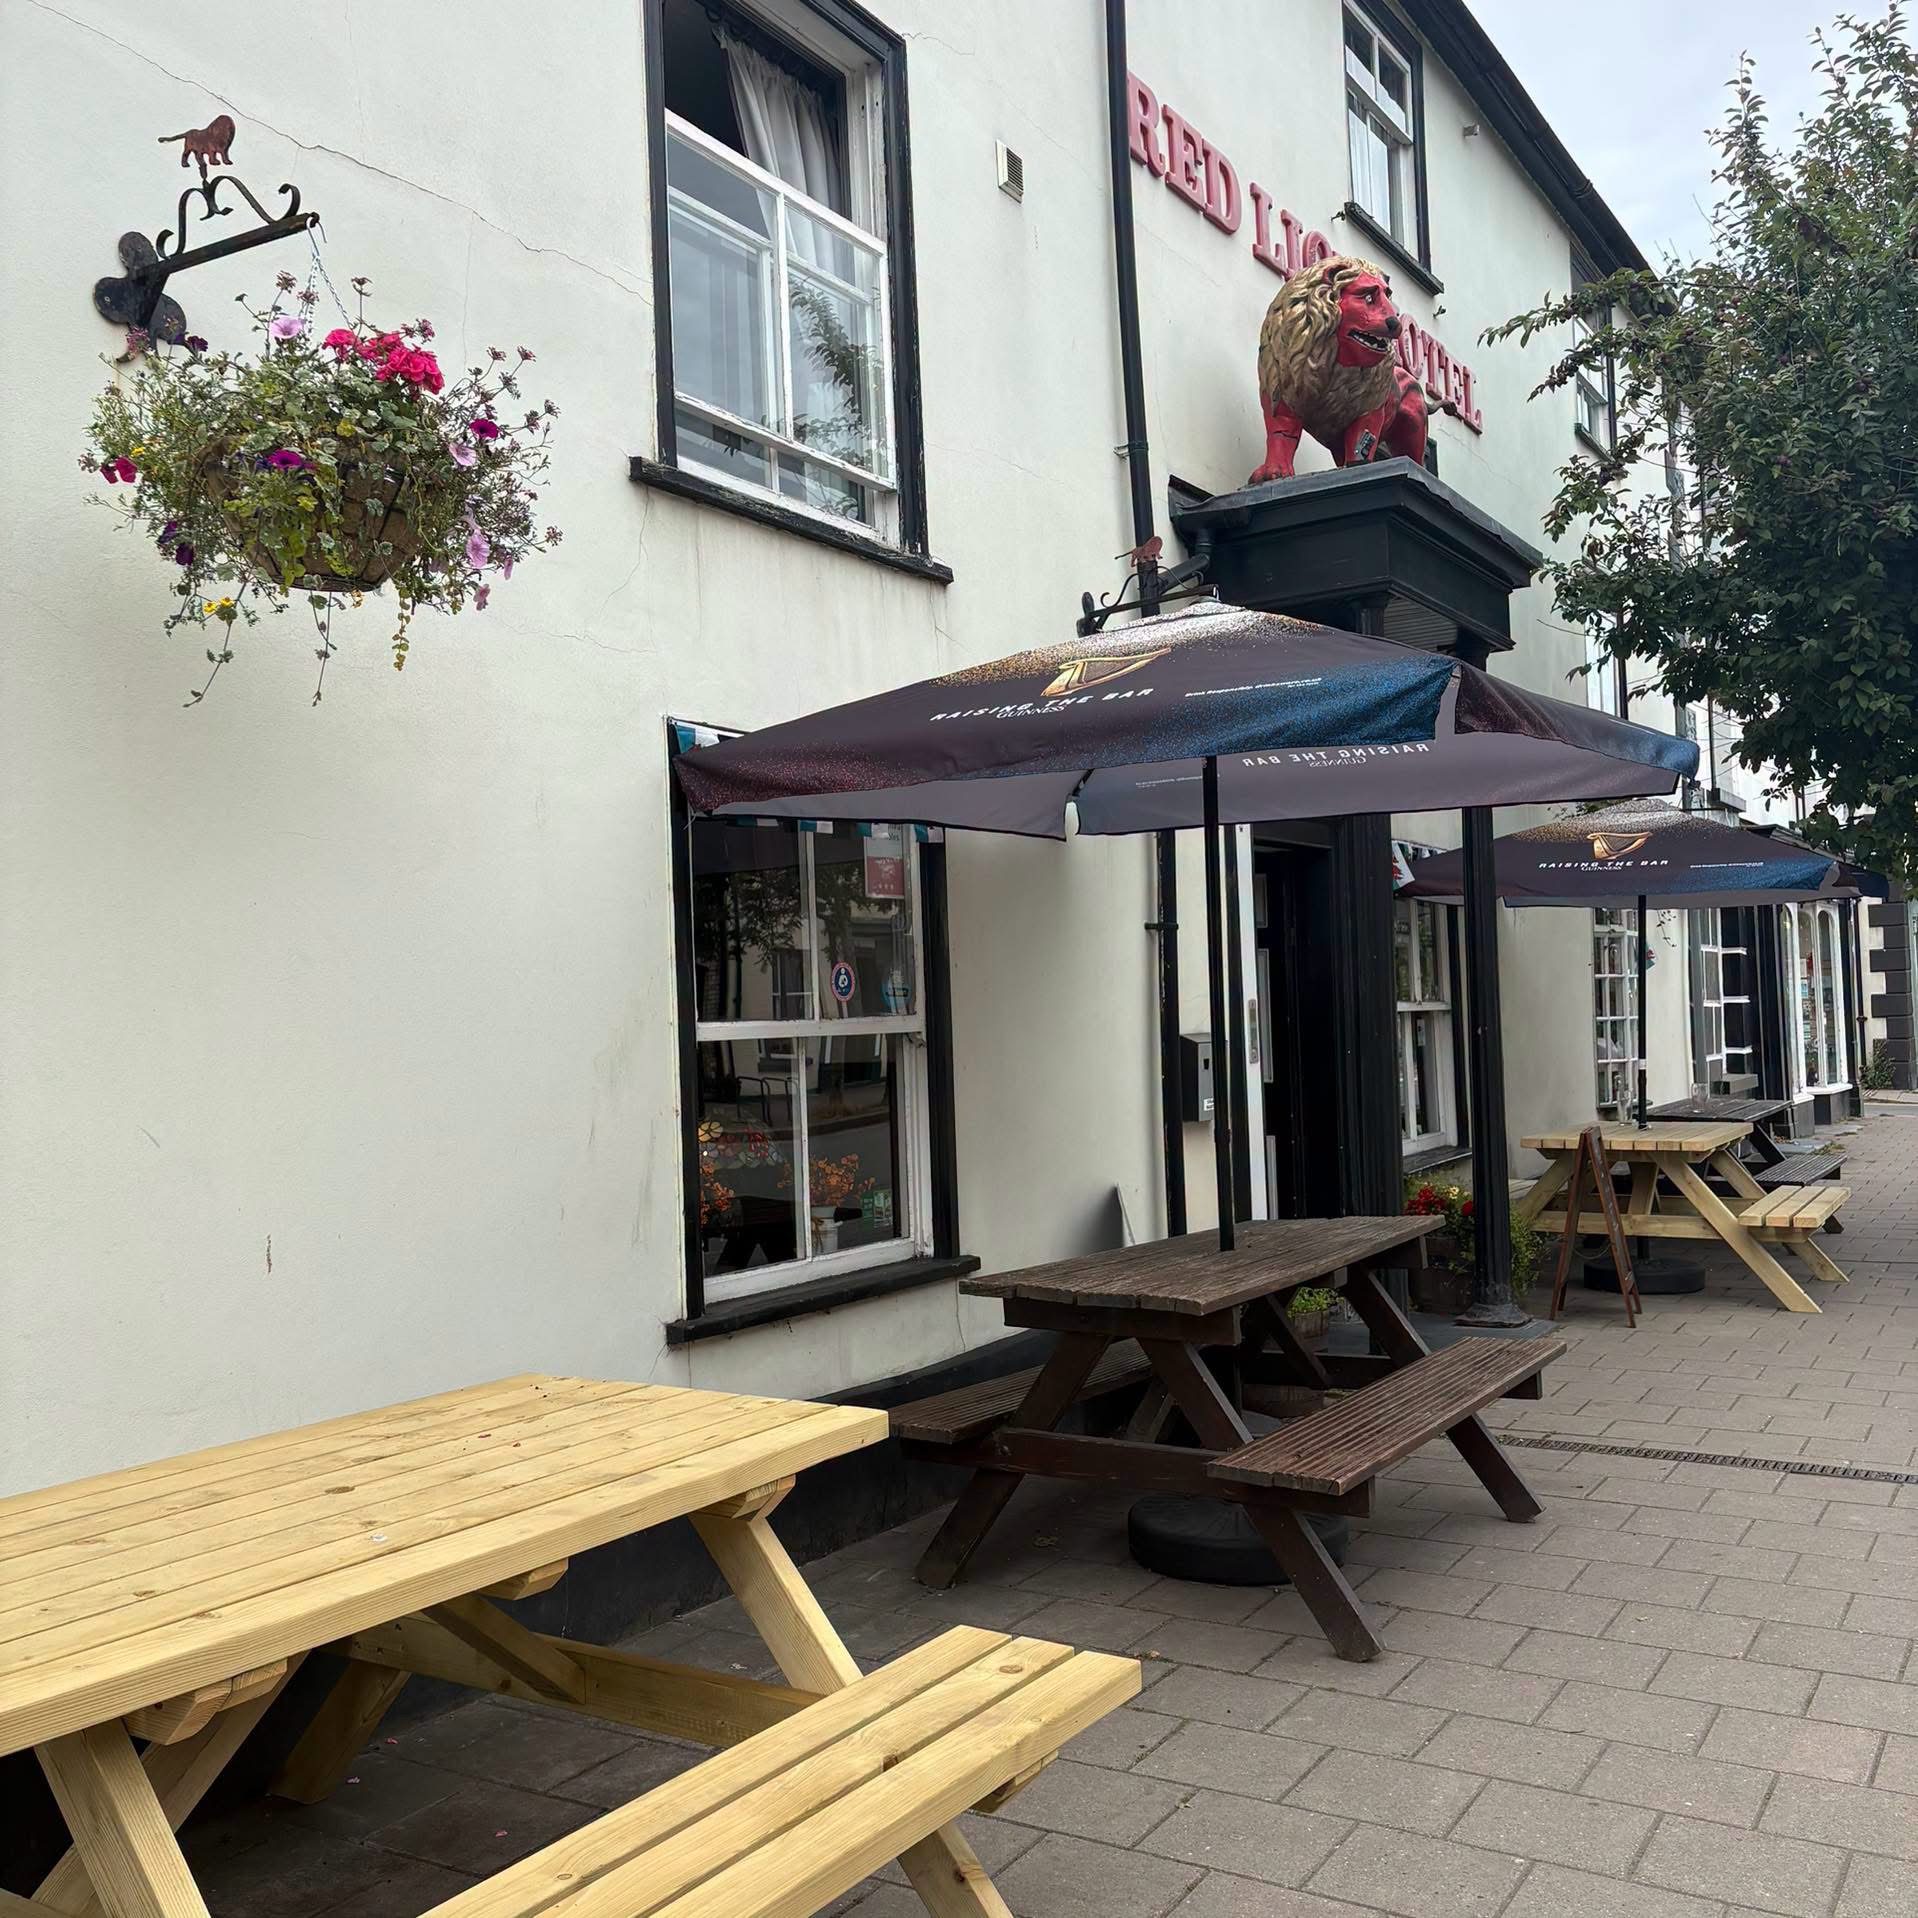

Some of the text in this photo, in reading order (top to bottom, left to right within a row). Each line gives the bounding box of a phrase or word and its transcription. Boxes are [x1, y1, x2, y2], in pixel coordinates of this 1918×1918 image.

[1127, 71, 1482, 436] RED LIO OTEL
[929, 688, 1154, 721] RAISING THE BAR
[996, 704, 1066, 719] GUINNESS
